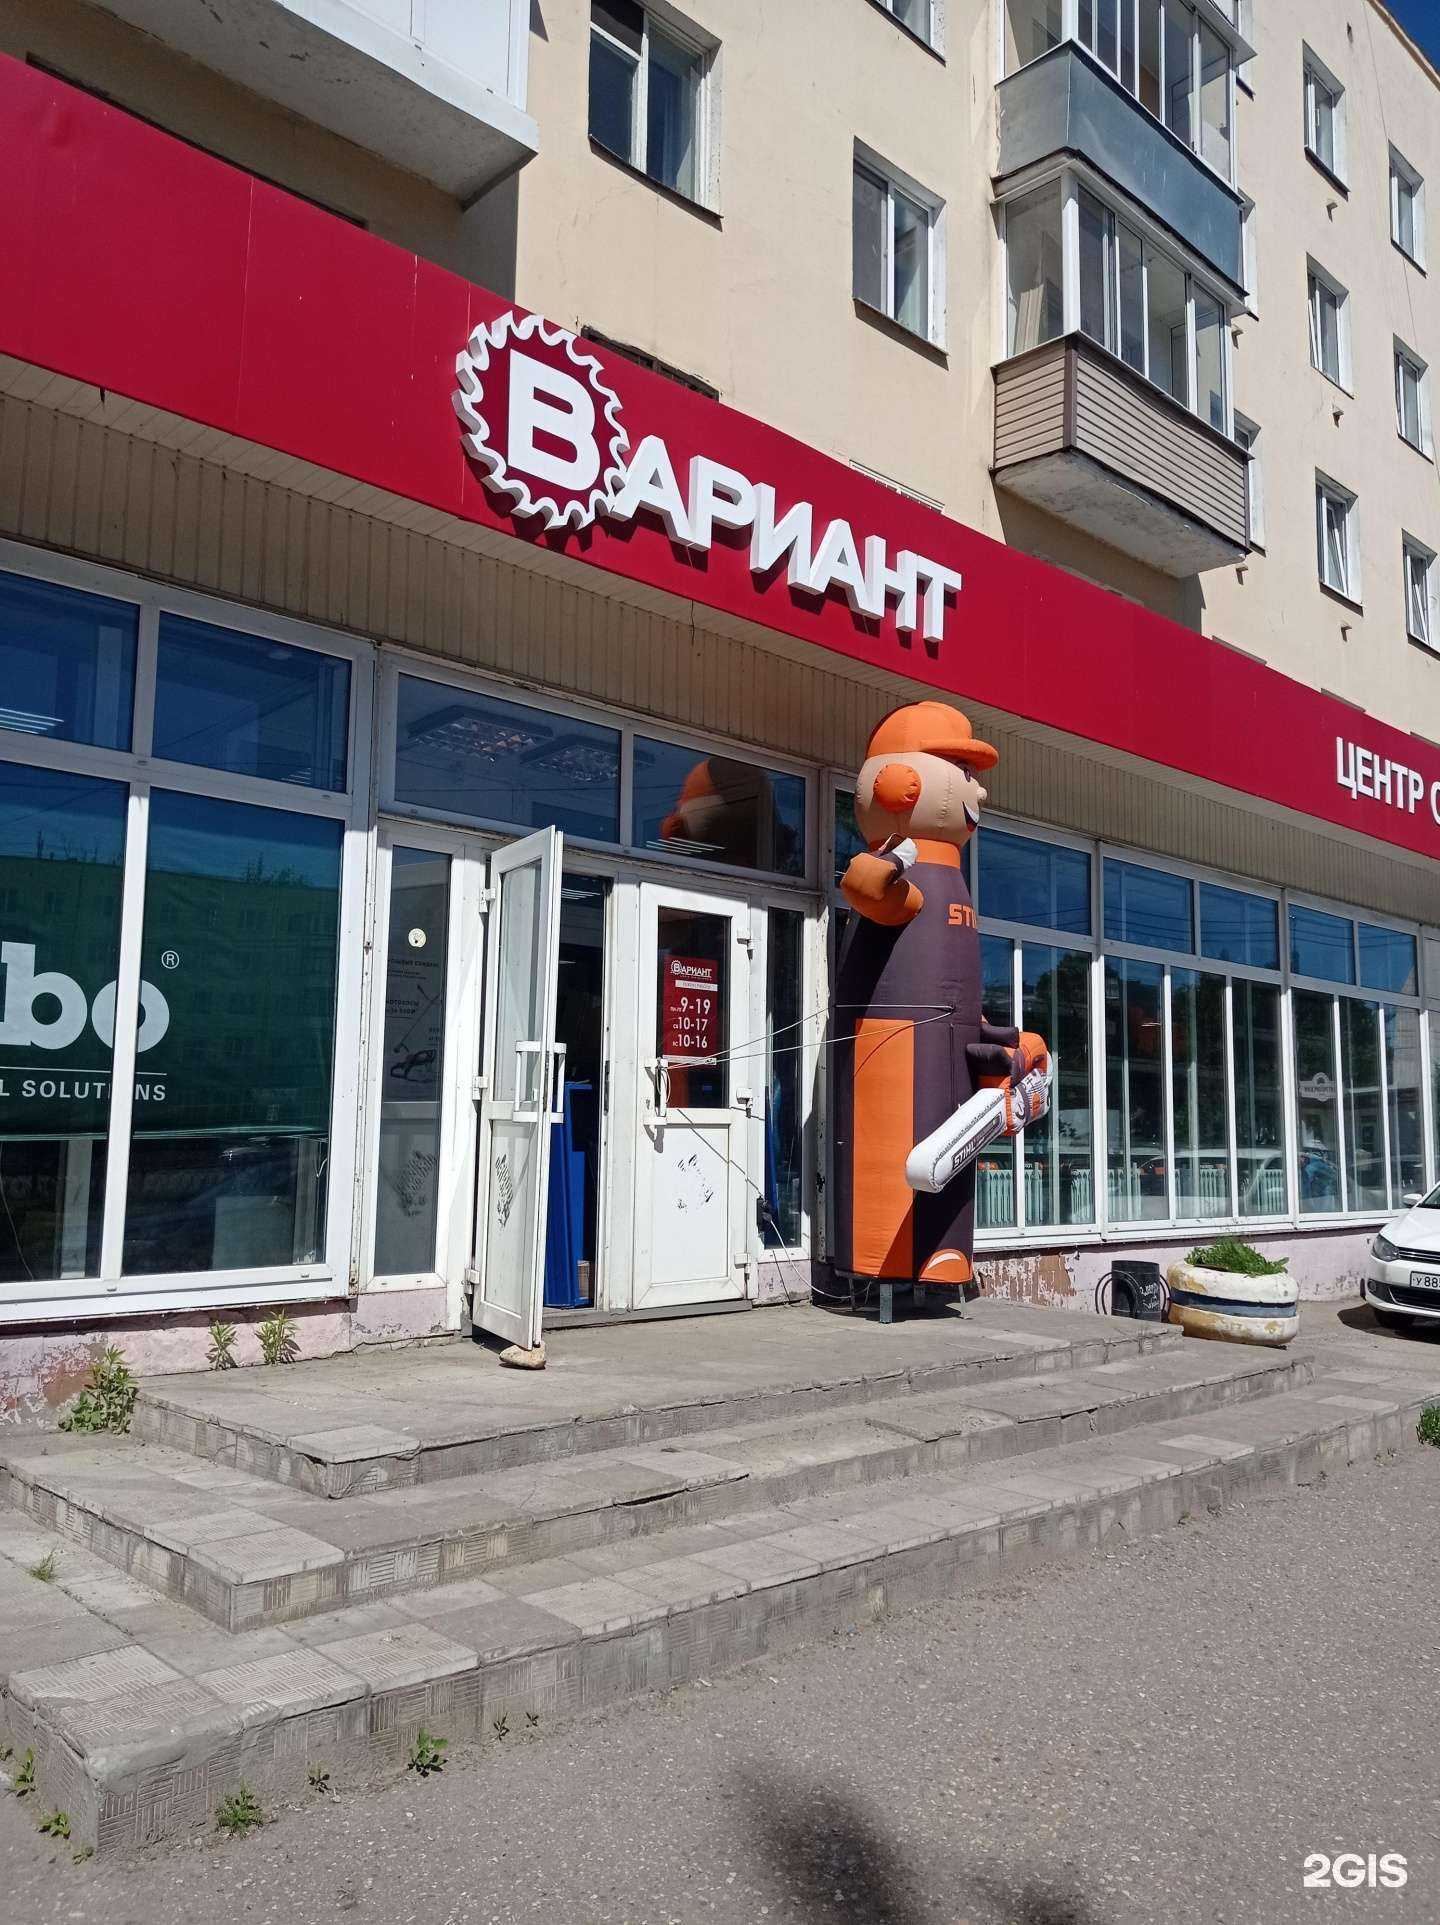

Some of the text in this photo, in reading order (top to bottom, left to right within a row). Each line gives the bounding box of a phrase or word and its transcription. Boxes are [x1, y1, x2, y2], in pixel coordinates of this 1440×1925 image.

[508, 348, 962, 643] ВАРИАНТ
[1335, 736, 1425, 815] ЦЕНТР
[671, 960, 712, 976] ВАРИАНТ
[681, 997, 711, 1014] 9-19
[678, 1016, 708, 1031] 10-17
[678, 1034, 708, 1049] 10-16
[21, 1080, 166, 1101] SOLUTNS
[1416, 1276, 1440, 1288] У88
